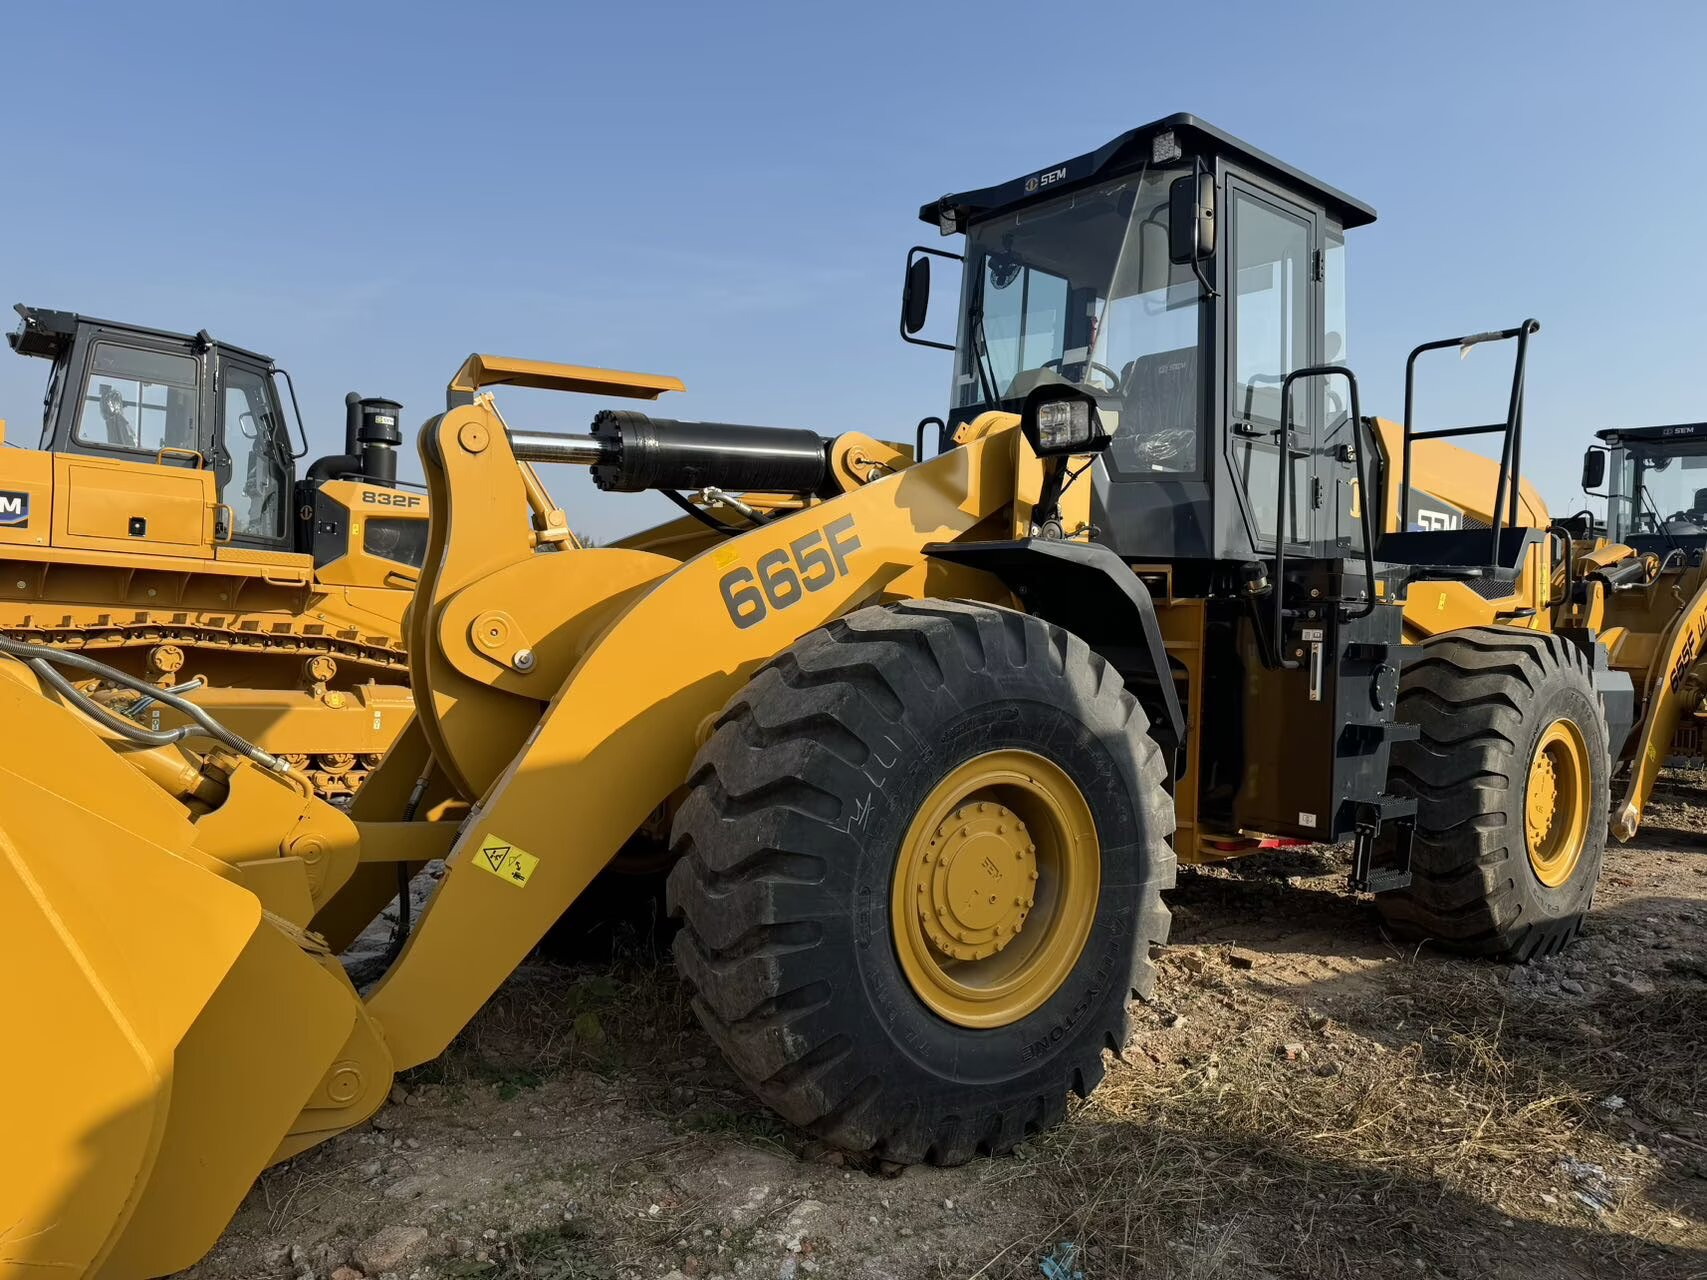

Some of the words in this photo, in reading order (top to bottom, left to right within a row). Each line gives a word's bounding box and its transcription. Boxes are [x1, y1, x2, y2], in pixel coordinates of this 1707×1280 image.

[1040, 167, 1067, 186] SEM
[1674, 426, 1695, 435] SEM
[362, 490, 421, 508] 832F
[719, 513, 862, 629] 665F
[1670, 629, 1695, 695] 655F
